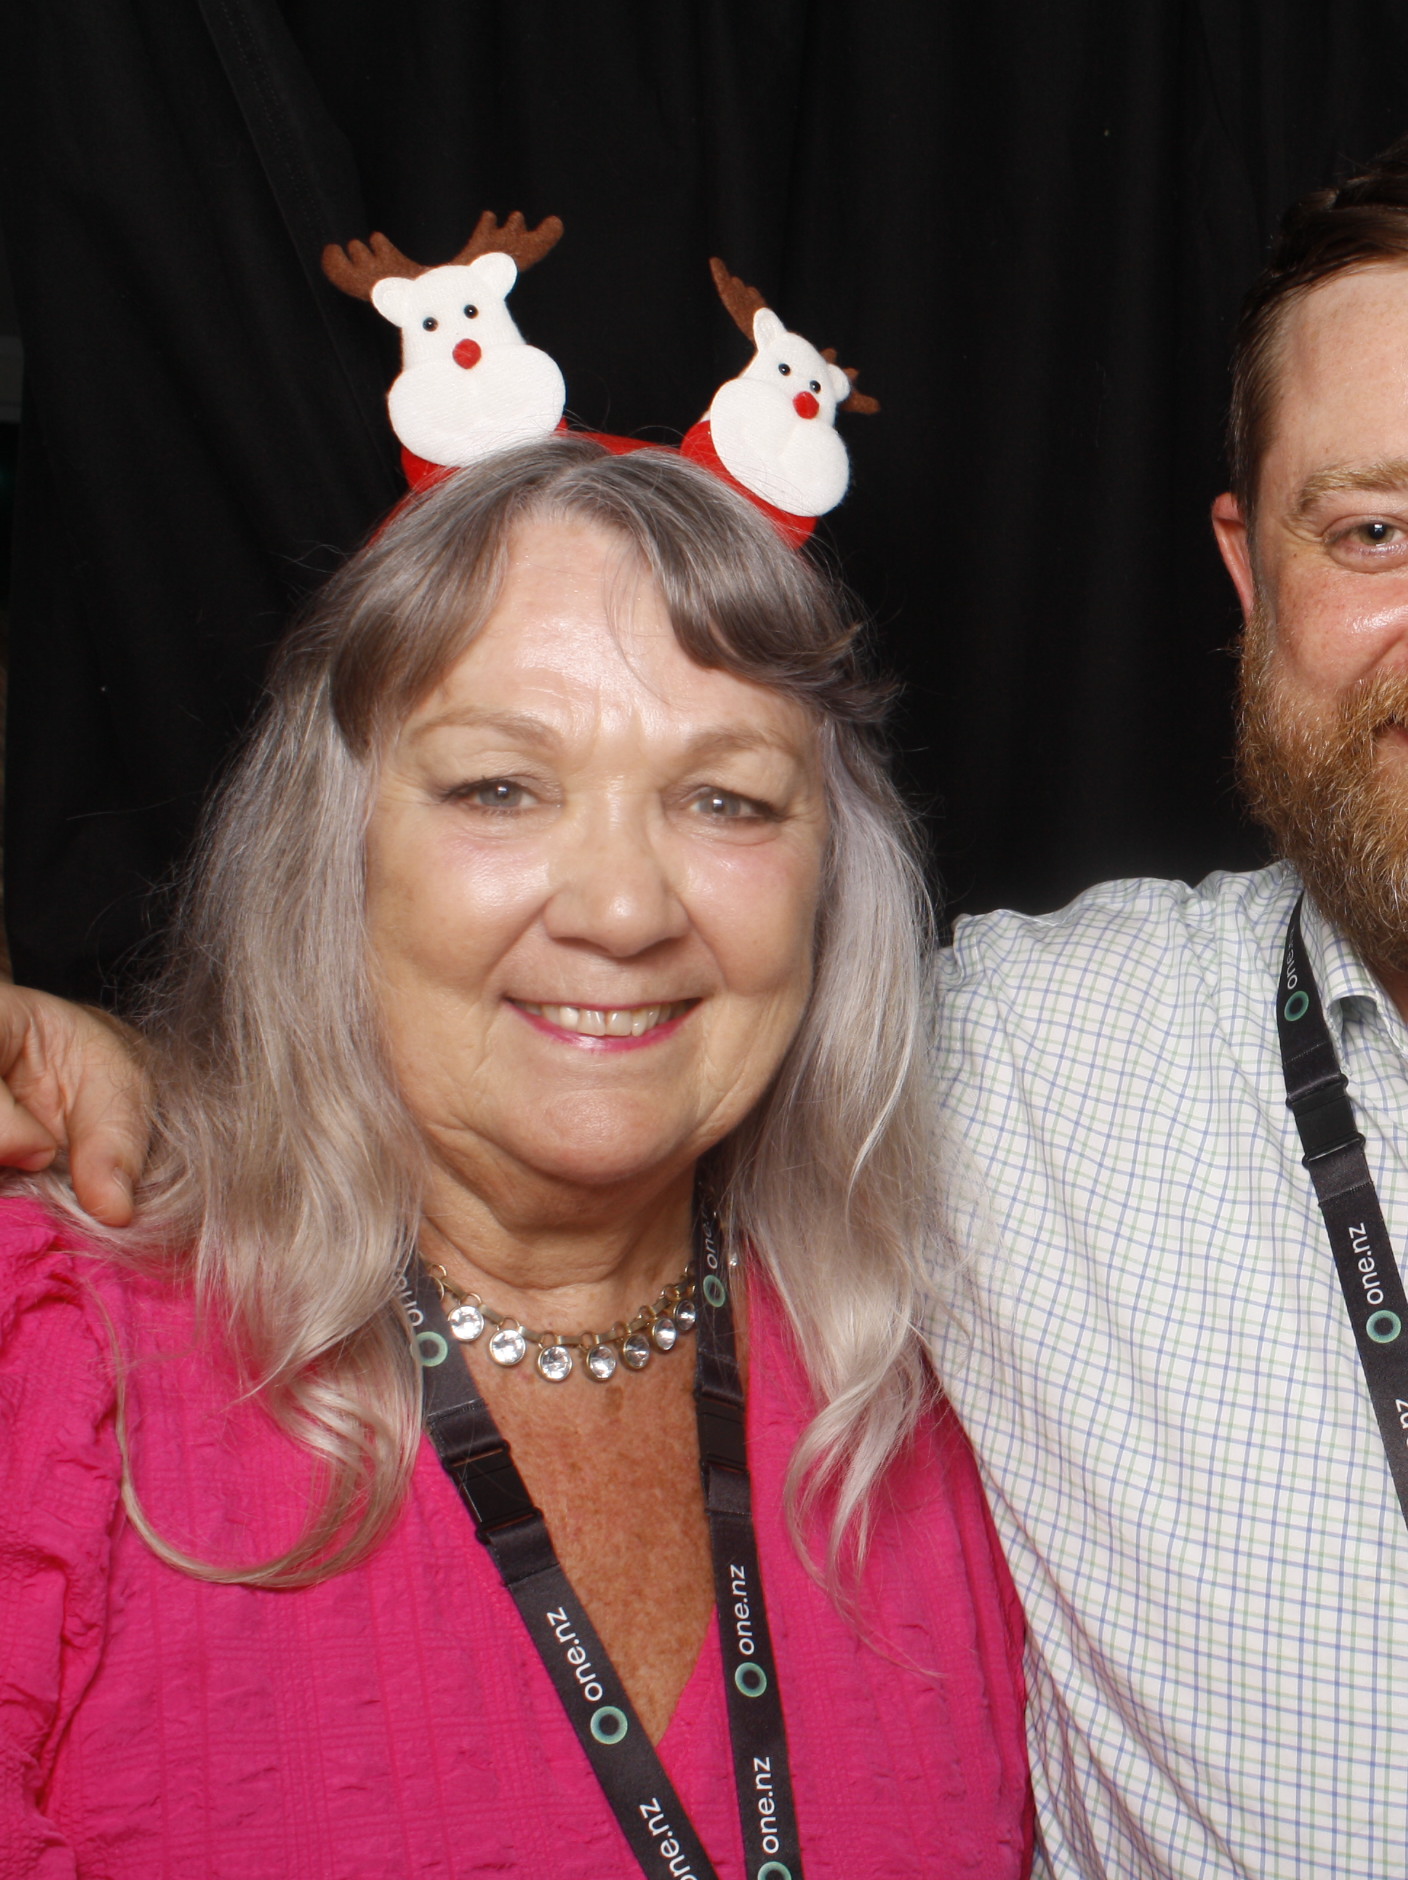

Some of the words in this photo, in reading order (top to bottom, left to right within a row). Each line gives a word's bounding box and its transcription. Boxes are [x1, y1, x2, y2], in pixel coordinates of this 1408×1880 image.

[1348, 1222, 1384, 1305] one.nz
[546, 1606, 603, 1702] one.nz
[730, 1564, 755, 1655] one.nz
[753, 1756, 780, 1854] one.nz
